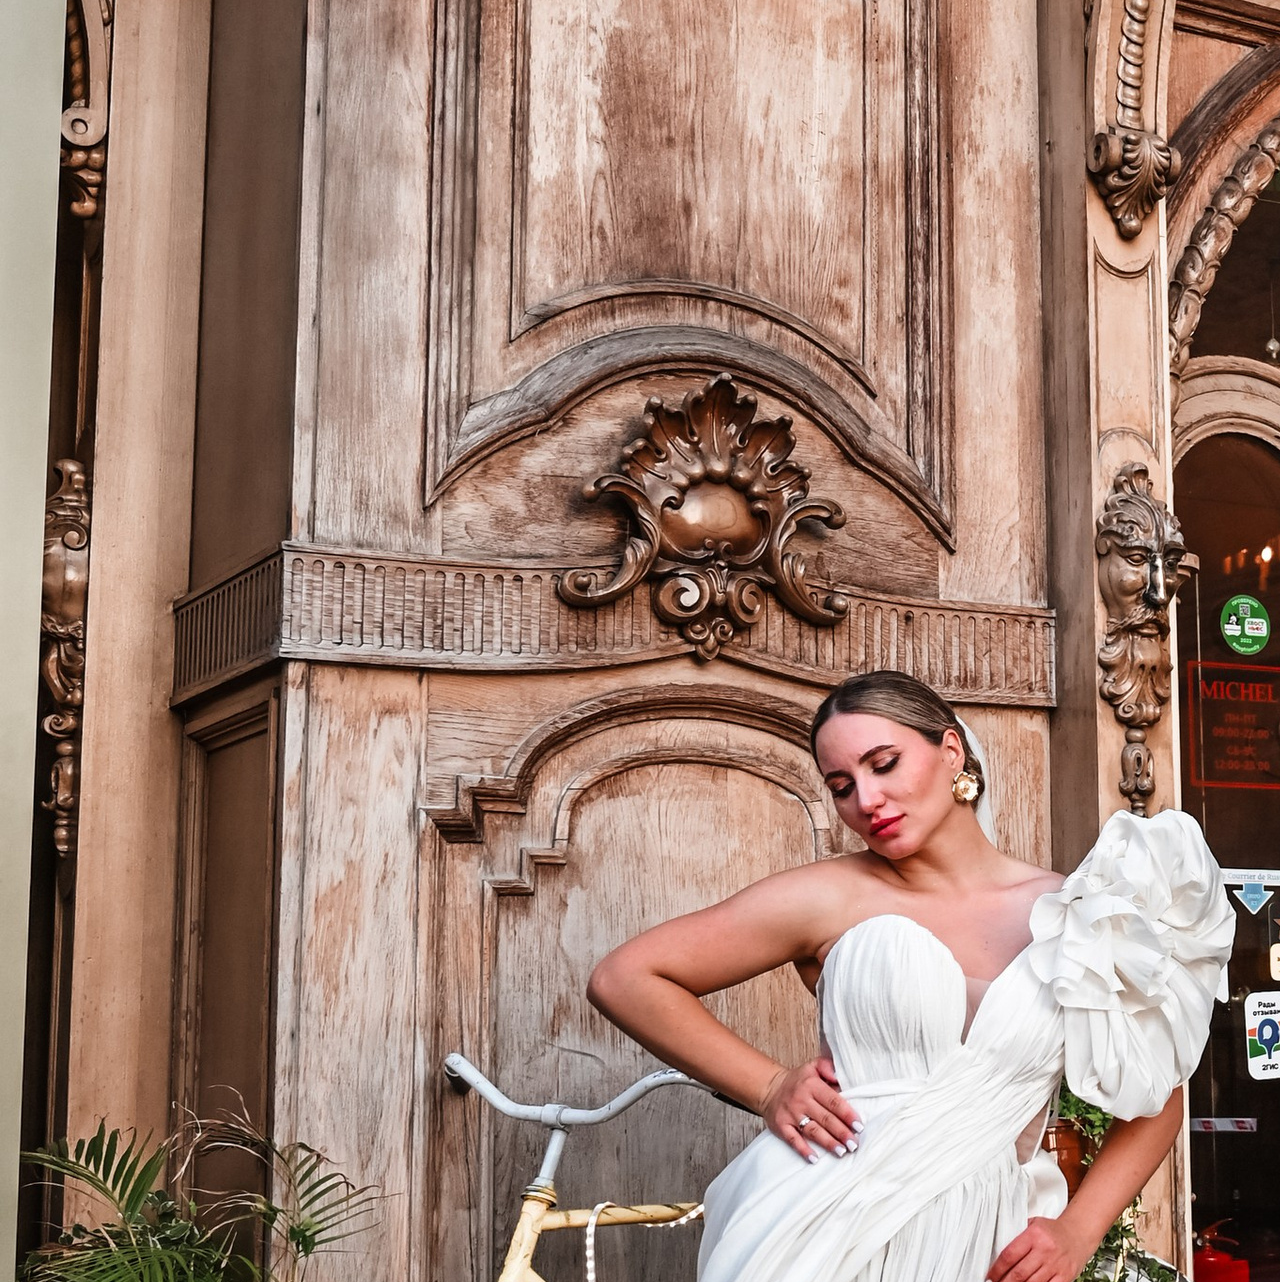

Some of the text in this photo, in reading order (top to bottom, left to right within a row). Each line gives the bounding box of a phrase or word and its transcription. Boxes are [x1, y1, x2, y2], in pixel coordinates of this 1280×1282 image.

[1231, 598, 1259, 608] ПРОВЕРЕНО
[1199, 679, 1278, 703] MICHEL
[1227, 873, 1256, 881] Courrier
[1257, 873, 1266, 881] de
[1261, 1063, 1279, 1071] 2ГИС
